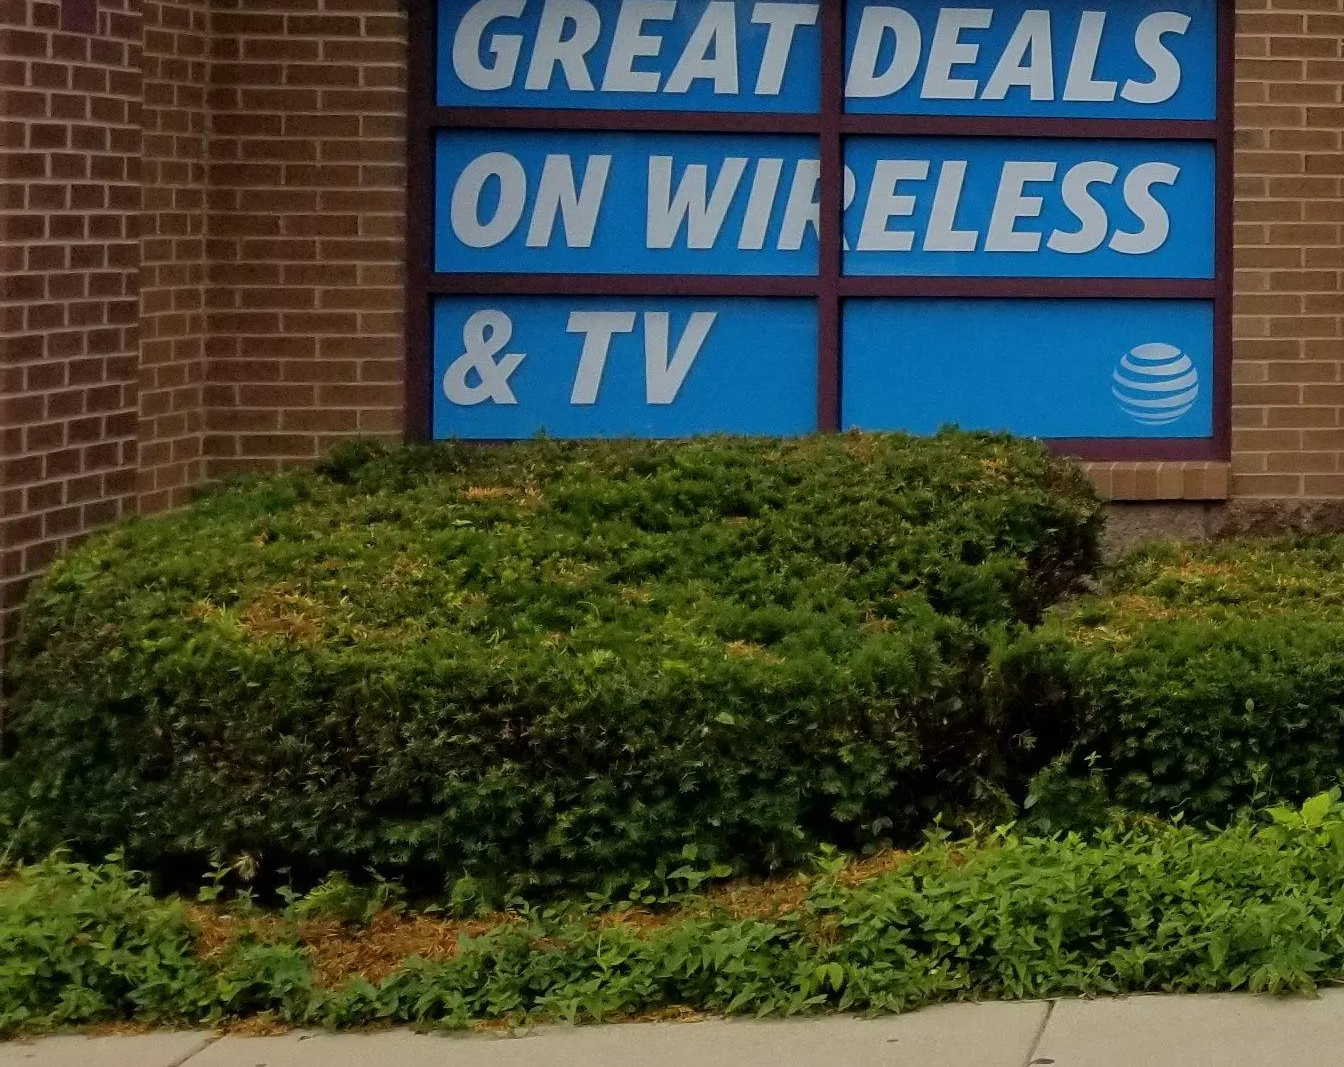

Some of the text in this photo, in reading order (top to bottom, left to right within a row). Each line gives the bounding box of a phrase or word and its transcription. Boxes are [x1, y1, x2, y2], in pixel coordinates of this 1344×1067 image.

[843, 4, 1193, 105] DEALS
[450, 150, 1181, 256] ON WIRELESS
[442, 309, 718, 406] & TV
